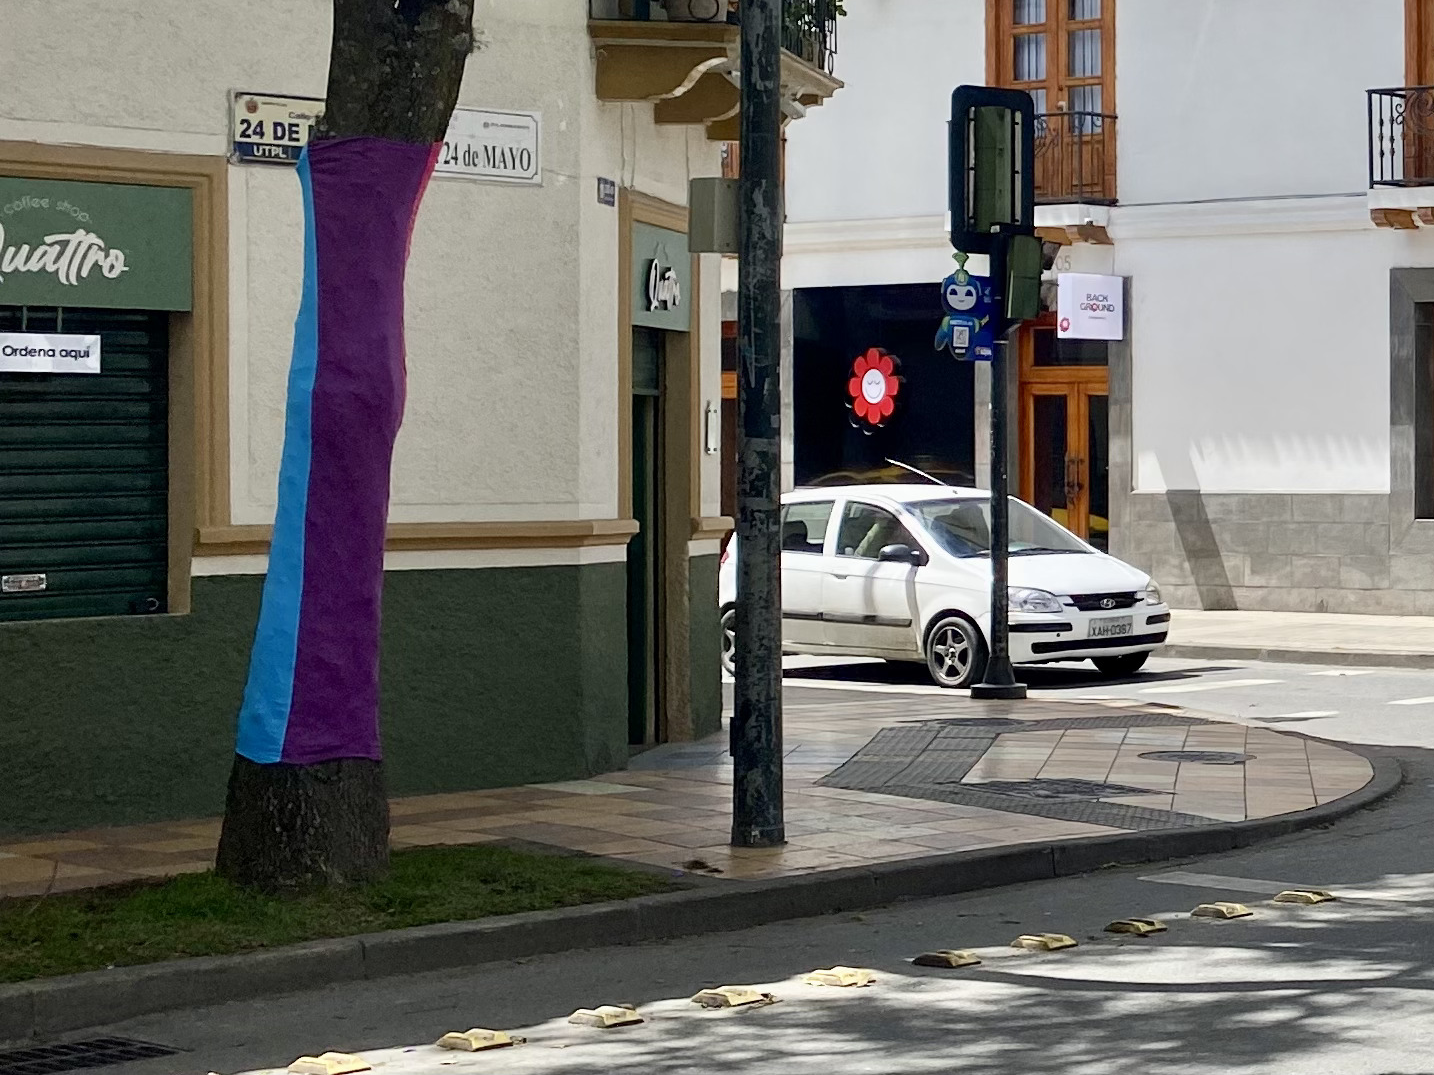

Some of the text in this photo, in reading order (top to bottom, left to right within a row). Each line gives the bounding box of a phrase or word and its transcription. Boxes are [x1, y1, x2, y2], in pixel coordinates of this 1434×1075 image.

[239, 118, 301, 142] 24 DE
[252, 145, 287, 159] UTPL
[443, 141, 532, 172] 24 de MAYO
[2, 345, 92, 362] Ordena aquí
